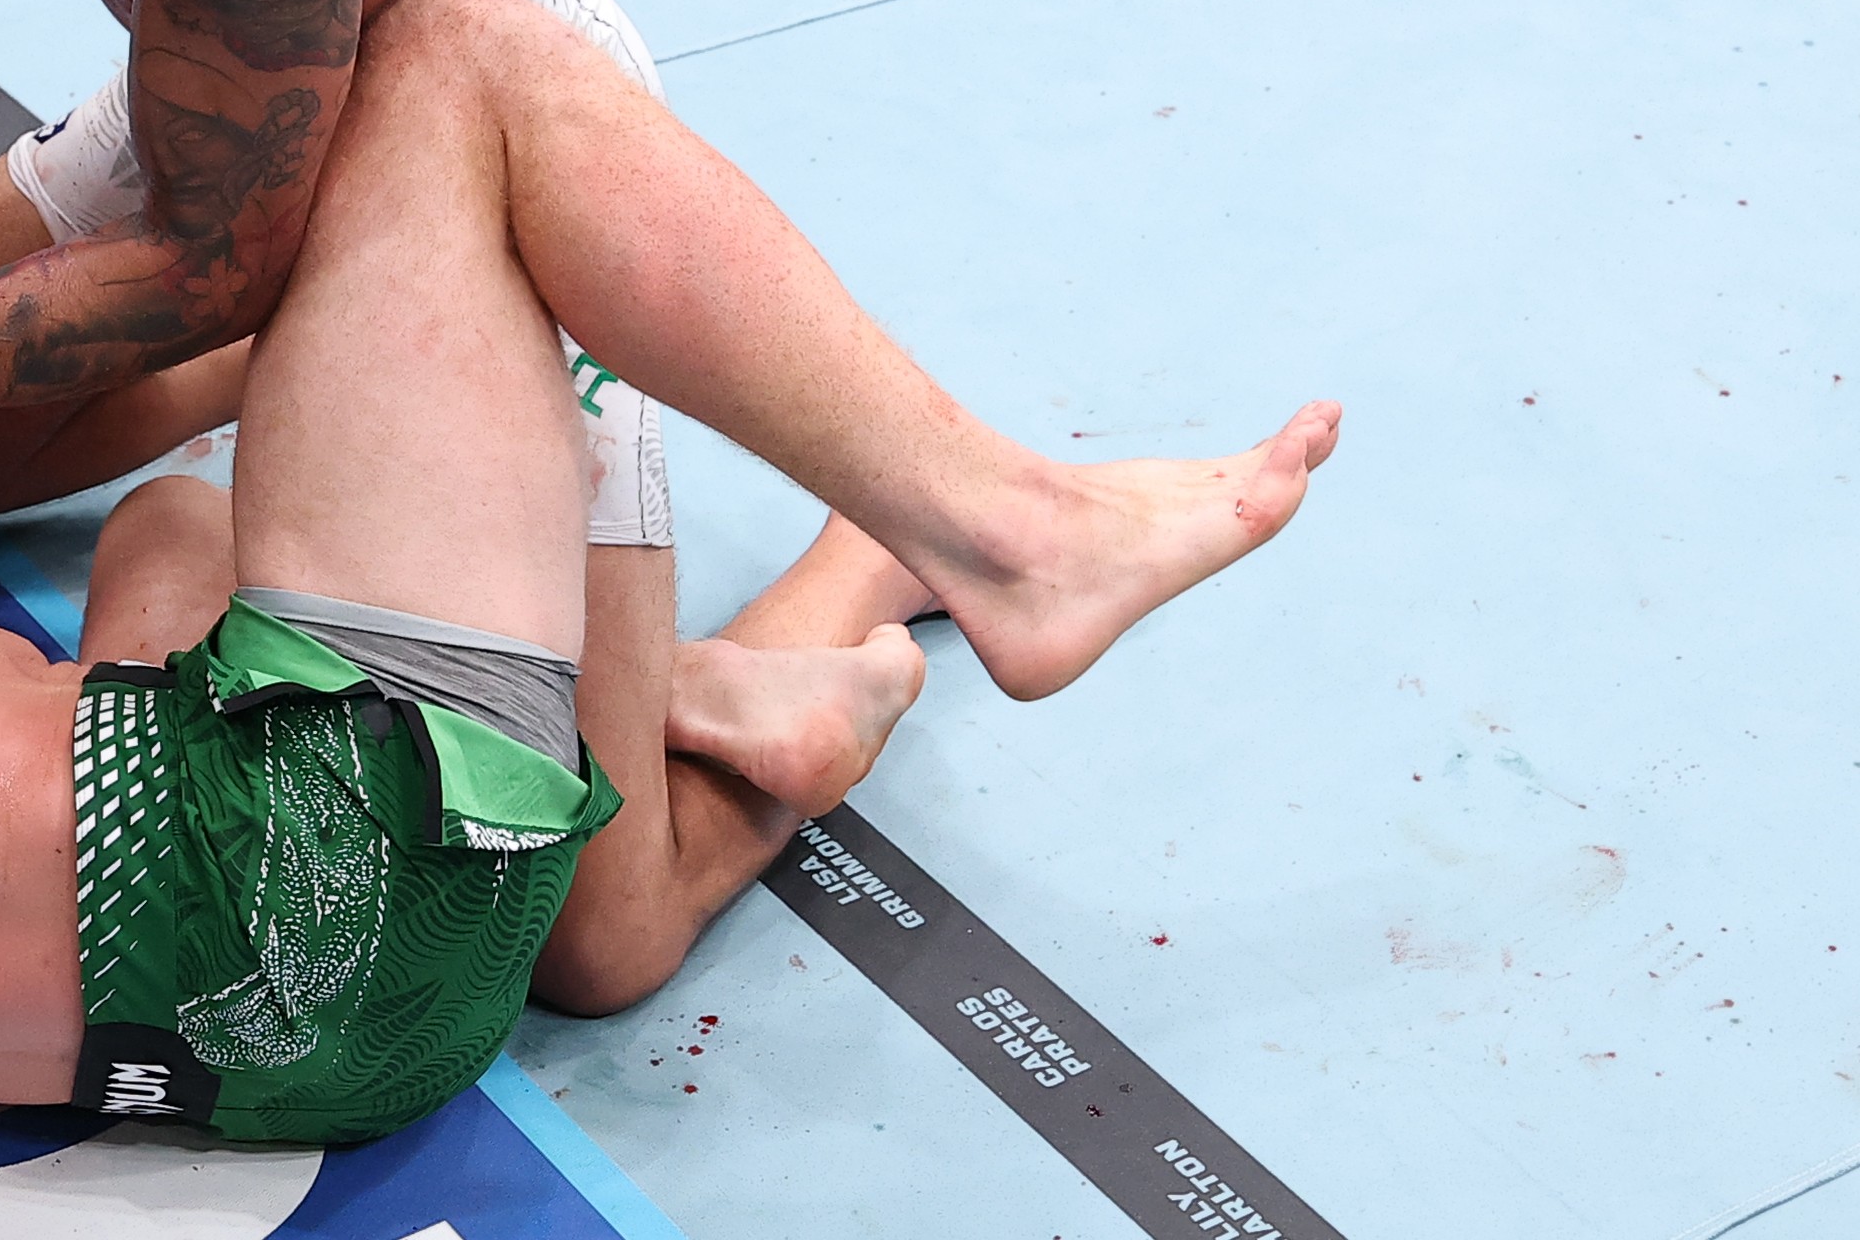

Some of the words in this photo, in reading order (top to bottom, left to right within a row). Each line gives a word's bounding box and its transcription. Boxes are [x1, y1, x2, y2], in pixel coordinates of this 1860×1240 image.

[797, 853, 859, 906] LISA
[954, 996, 1068, 1090] CARLOS
[981, 985, 1093, 1078] PRATES
